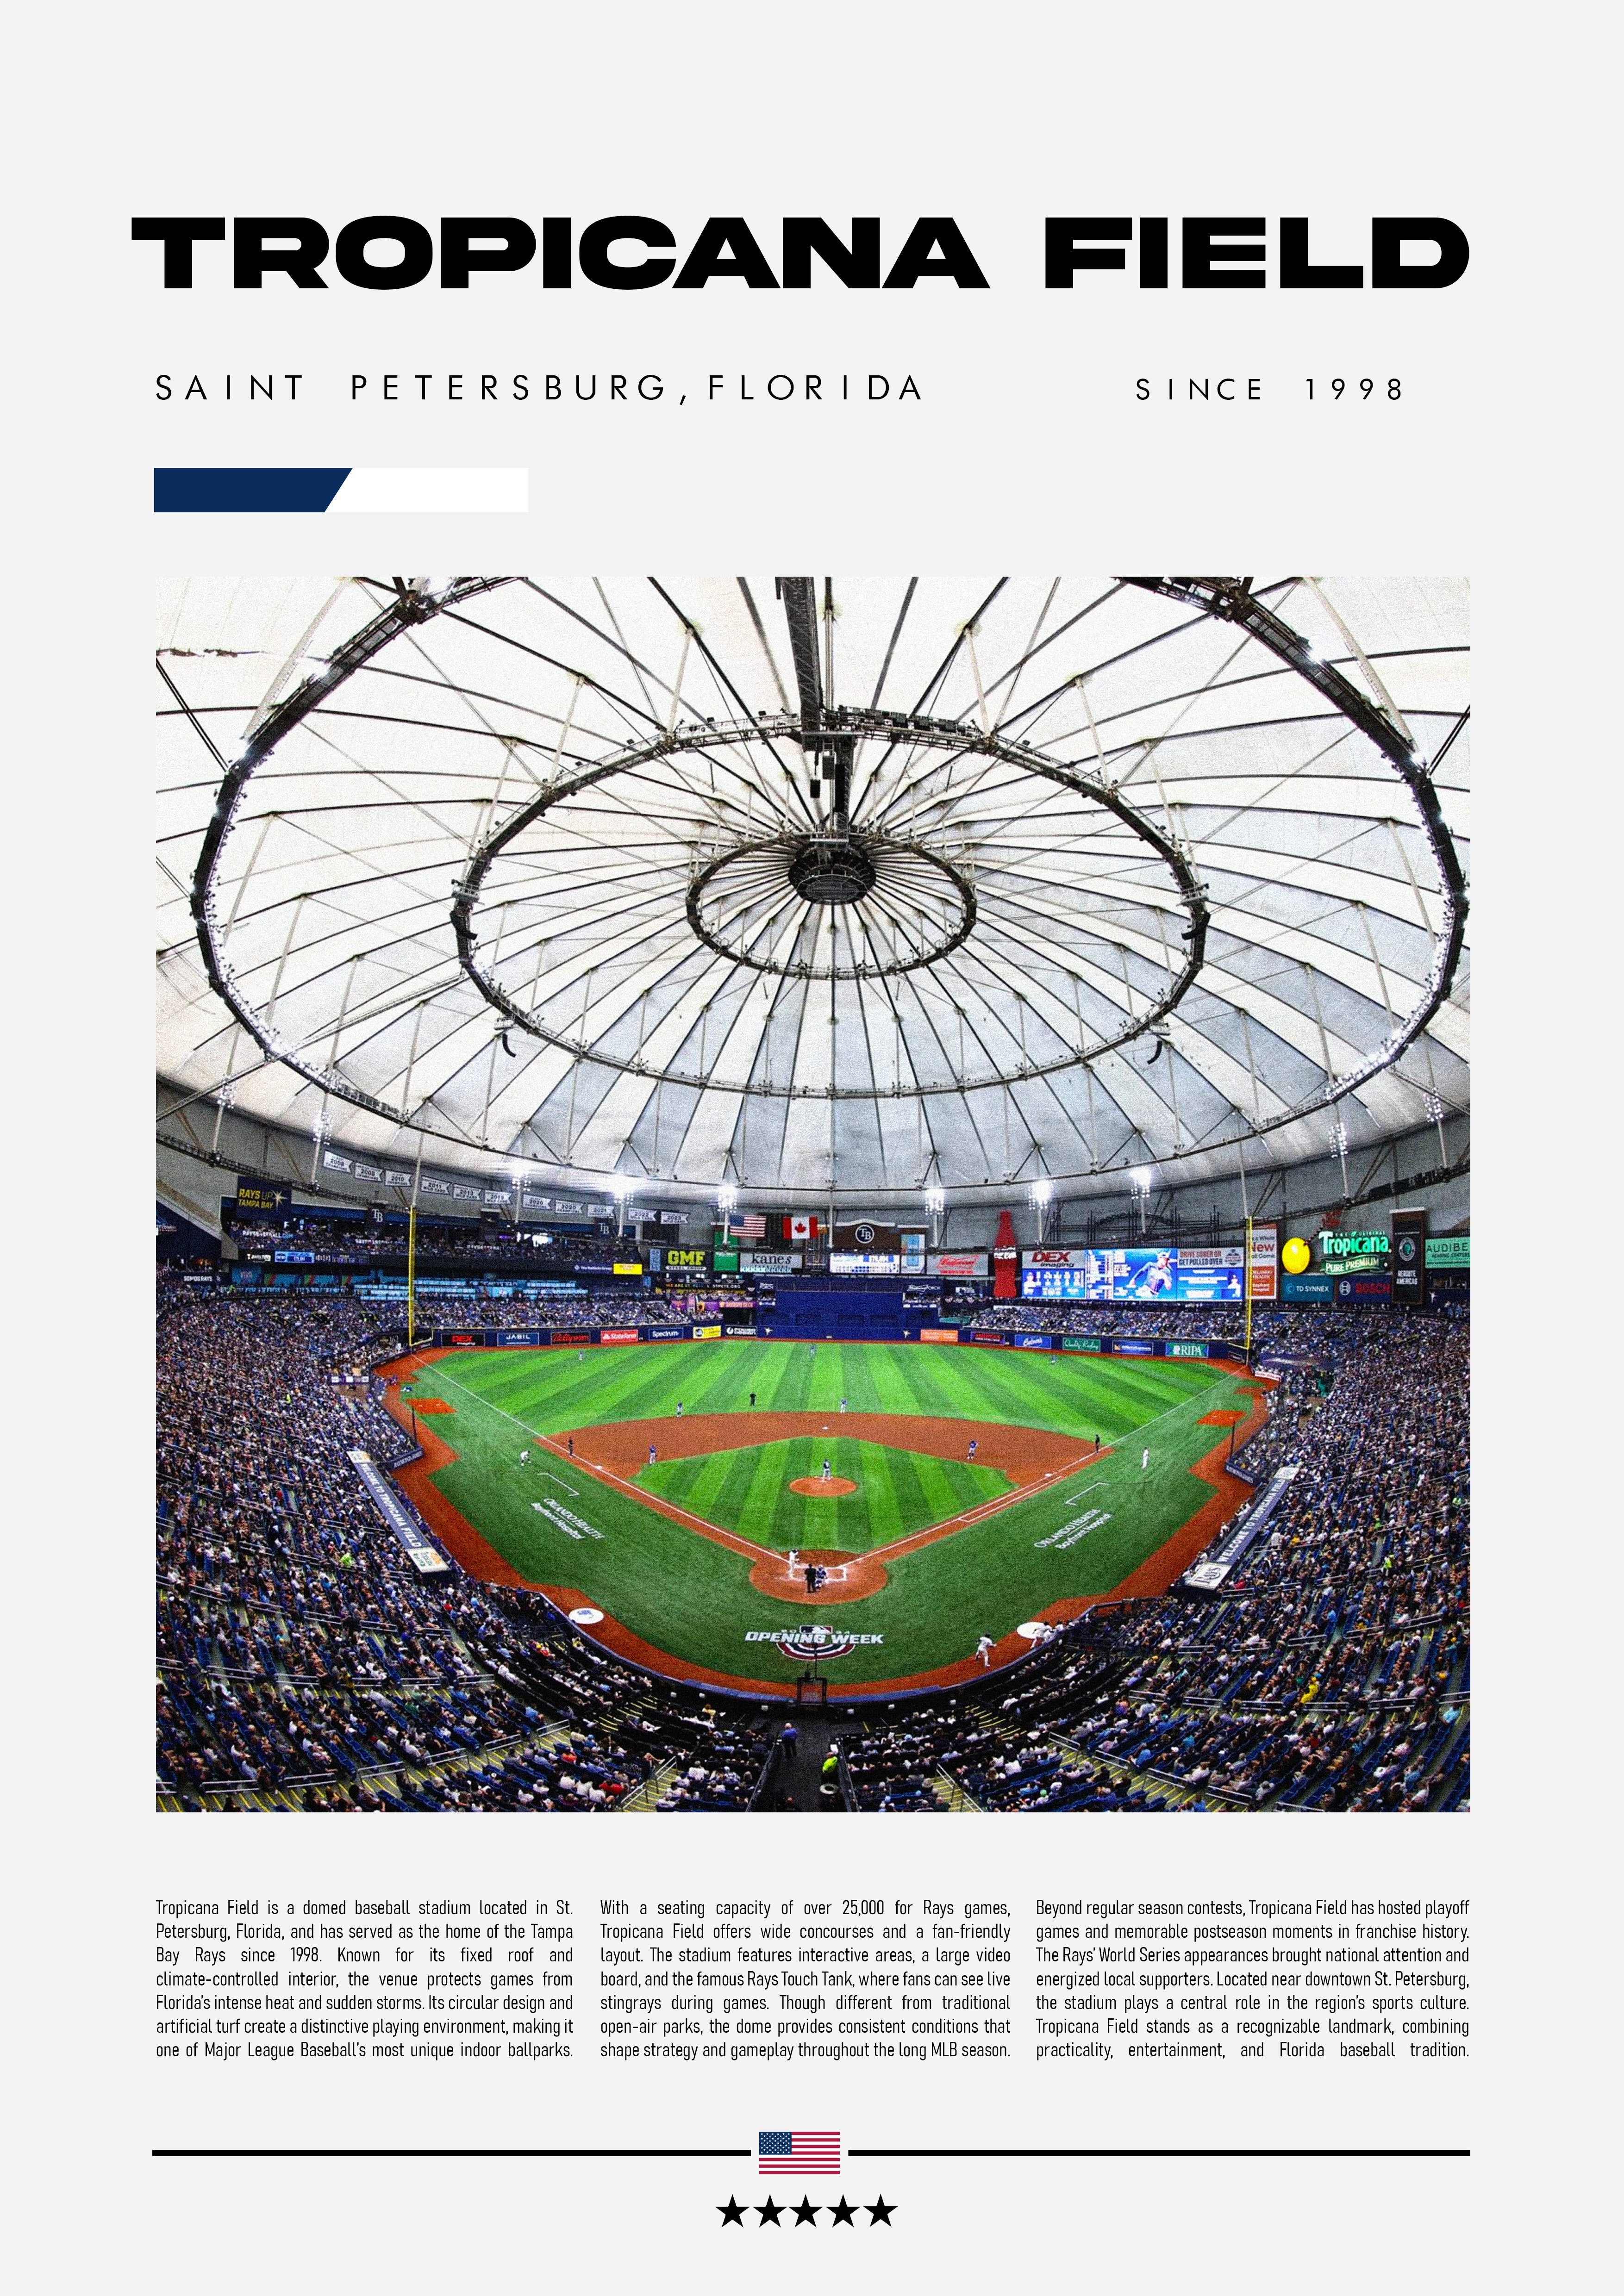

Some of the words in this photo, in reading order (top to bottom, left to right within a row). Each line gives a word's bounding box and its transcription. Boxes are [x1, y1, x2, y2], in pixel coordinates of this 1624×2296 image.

[239, 1188, 261, 1200] RAYS
[238, 1199, 260, 1207] TAMPA
[1319, 1231, 1388, 1257] Tropicana
[668, 1251, 705, 1265] GMF
[1032, 1251, 1071, 1262] DEX
[1325, 1263, 1345, 1272] PURE
[1345, 1257, 1380, 1270] PREMIUM
[1181, 1345, 1203, 1356] RIPA
[400, 1527, 422, 1548] FIELD
[1217, 1529, 1249, 1563] WELCOME
[744, 1631, 825, 1643] OPENING
[831, 1634, 884, 1644] WEEK
